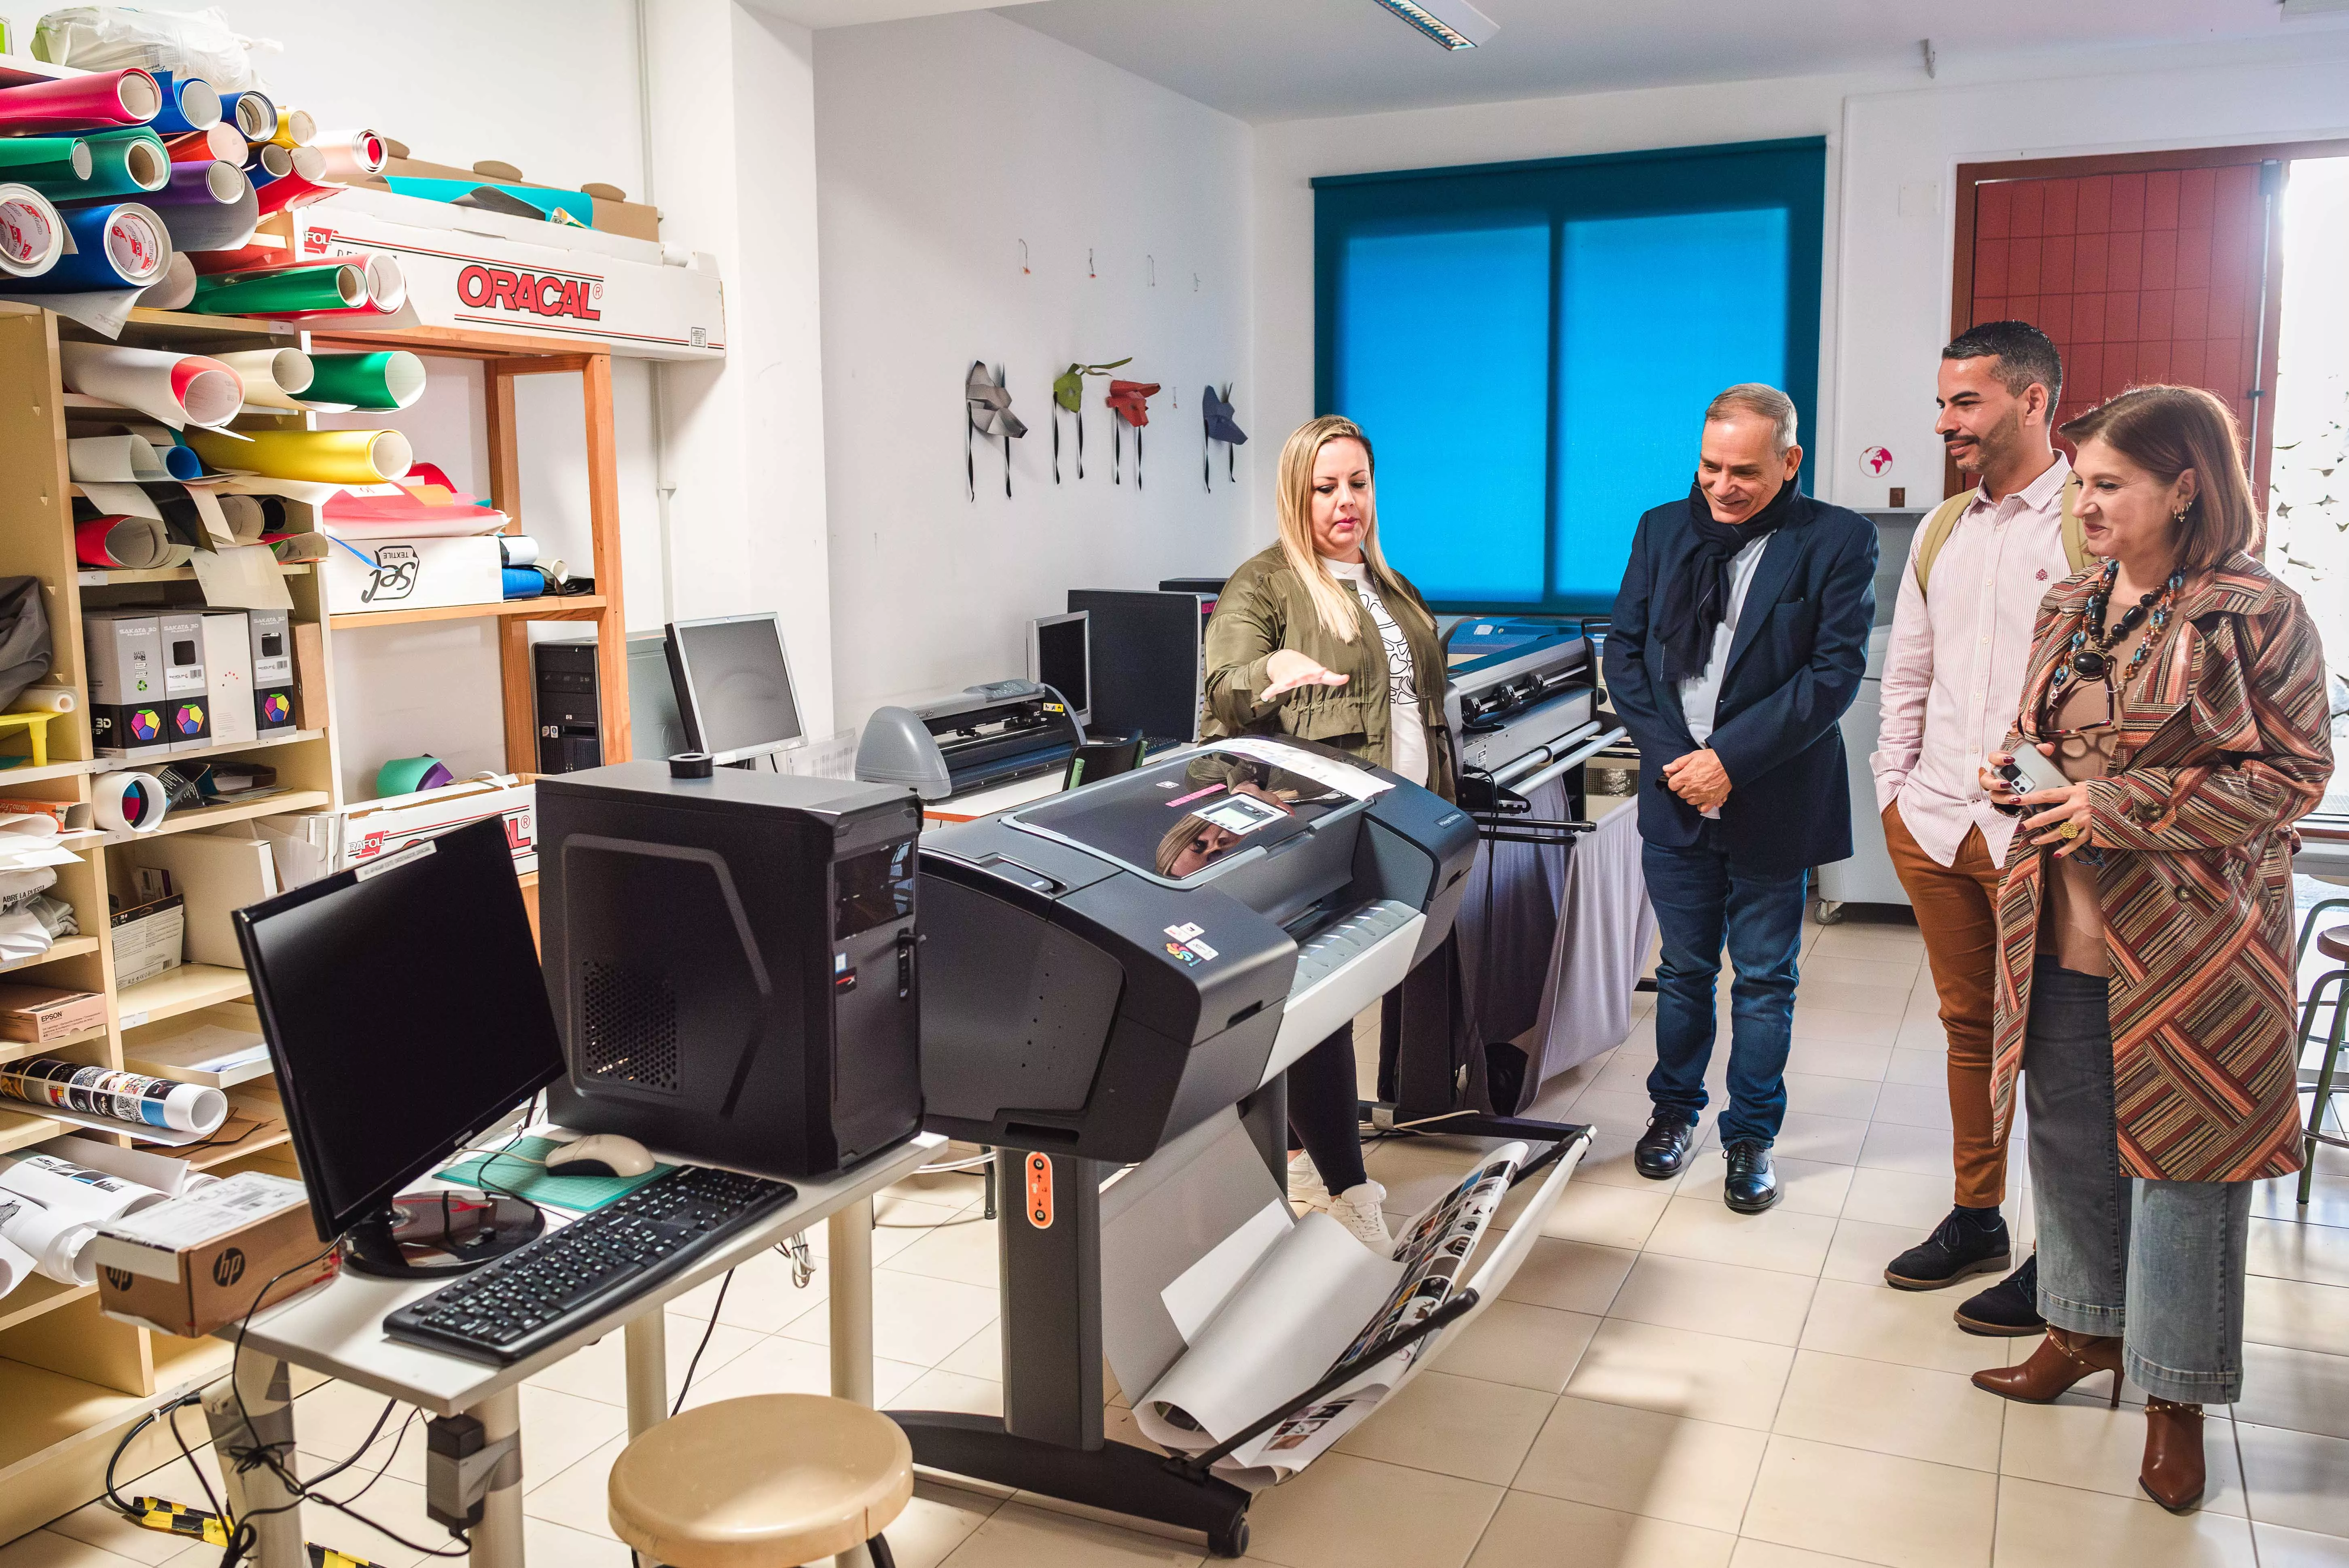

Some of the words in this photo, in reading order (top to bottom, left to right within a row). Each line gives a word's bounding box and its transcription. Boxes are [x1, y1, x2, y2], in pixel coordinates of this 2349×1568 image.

[95, 718, 112, 728] 3D
[3, 893, 19, 903] ABRE
[41, 1011, 62, 1022] EPSON
[218, 1251, 242, 1287] hp
